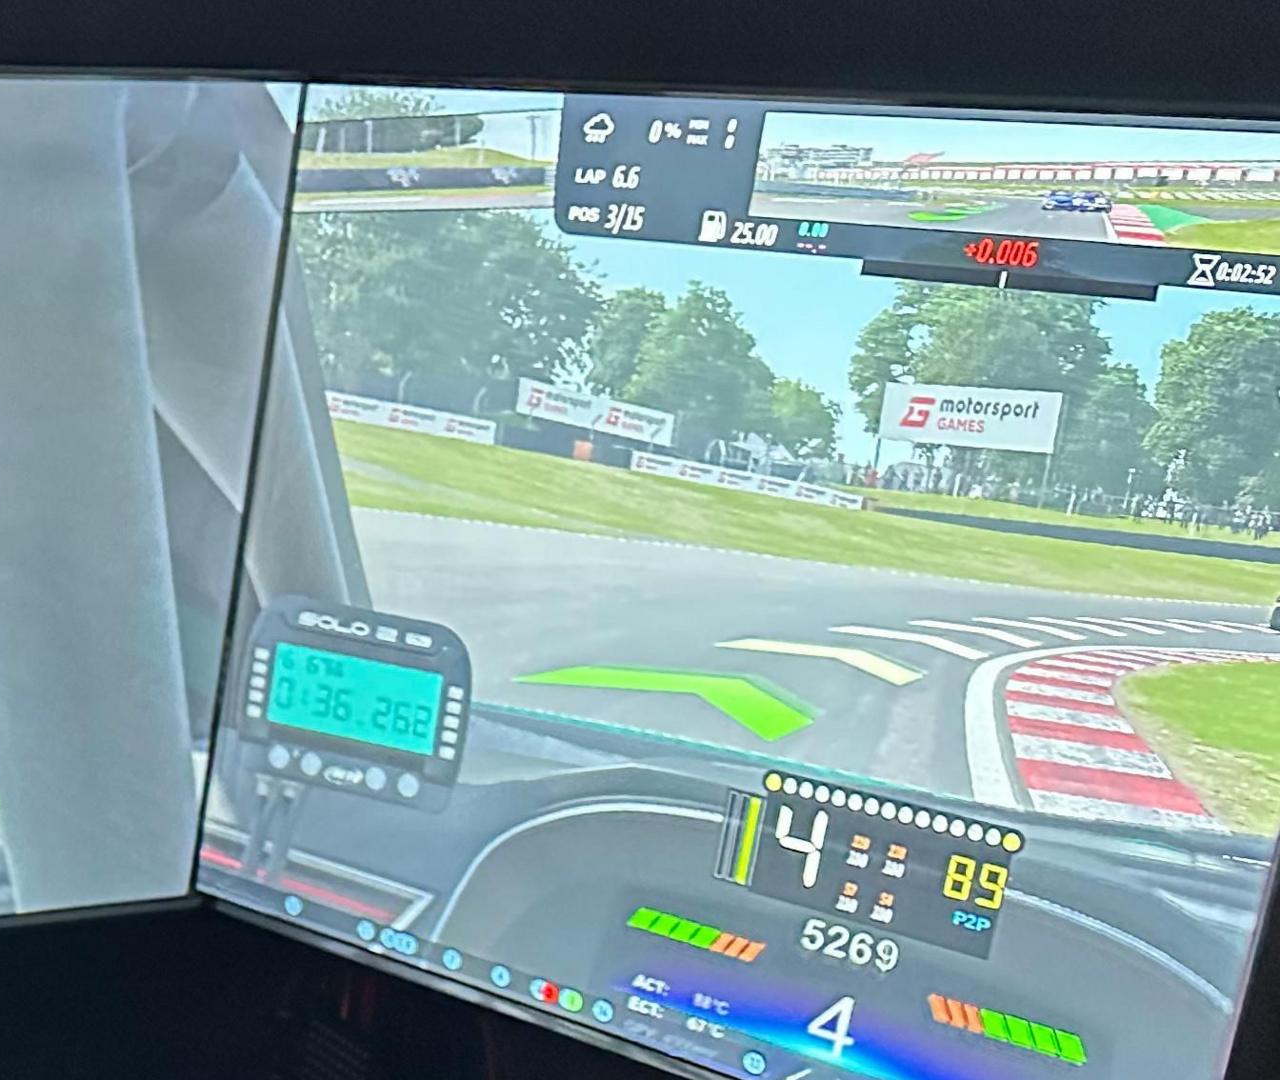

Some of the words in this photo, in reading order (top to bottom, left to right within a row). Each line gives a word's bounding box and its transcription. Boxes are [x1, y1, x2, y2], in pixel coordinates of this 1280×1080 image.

[574, 167, 607, 184] LAP
[612, 164, 641, 190] 6.6
[568, 205, 600, 223] POS
[604, 203, 645, 234] 3/15
[730, 221, 779, 247] 25.00
[962, 238, 1040, 268] +0.006
[1215, 261, 1278, 285] 0:02:52
[940, 395, 1040, 421] motorsport
[937, 416, 986, 434] GAMES
[275, 677, 433, 739] 0:36.262
[775, 804, 830, 888] 4
[942, 854, 1008, 910] 89
[951, 910, 992, 932] P2P
[801, 917, 901, 973] 5269
[806, 995, 856, 1060] 4
